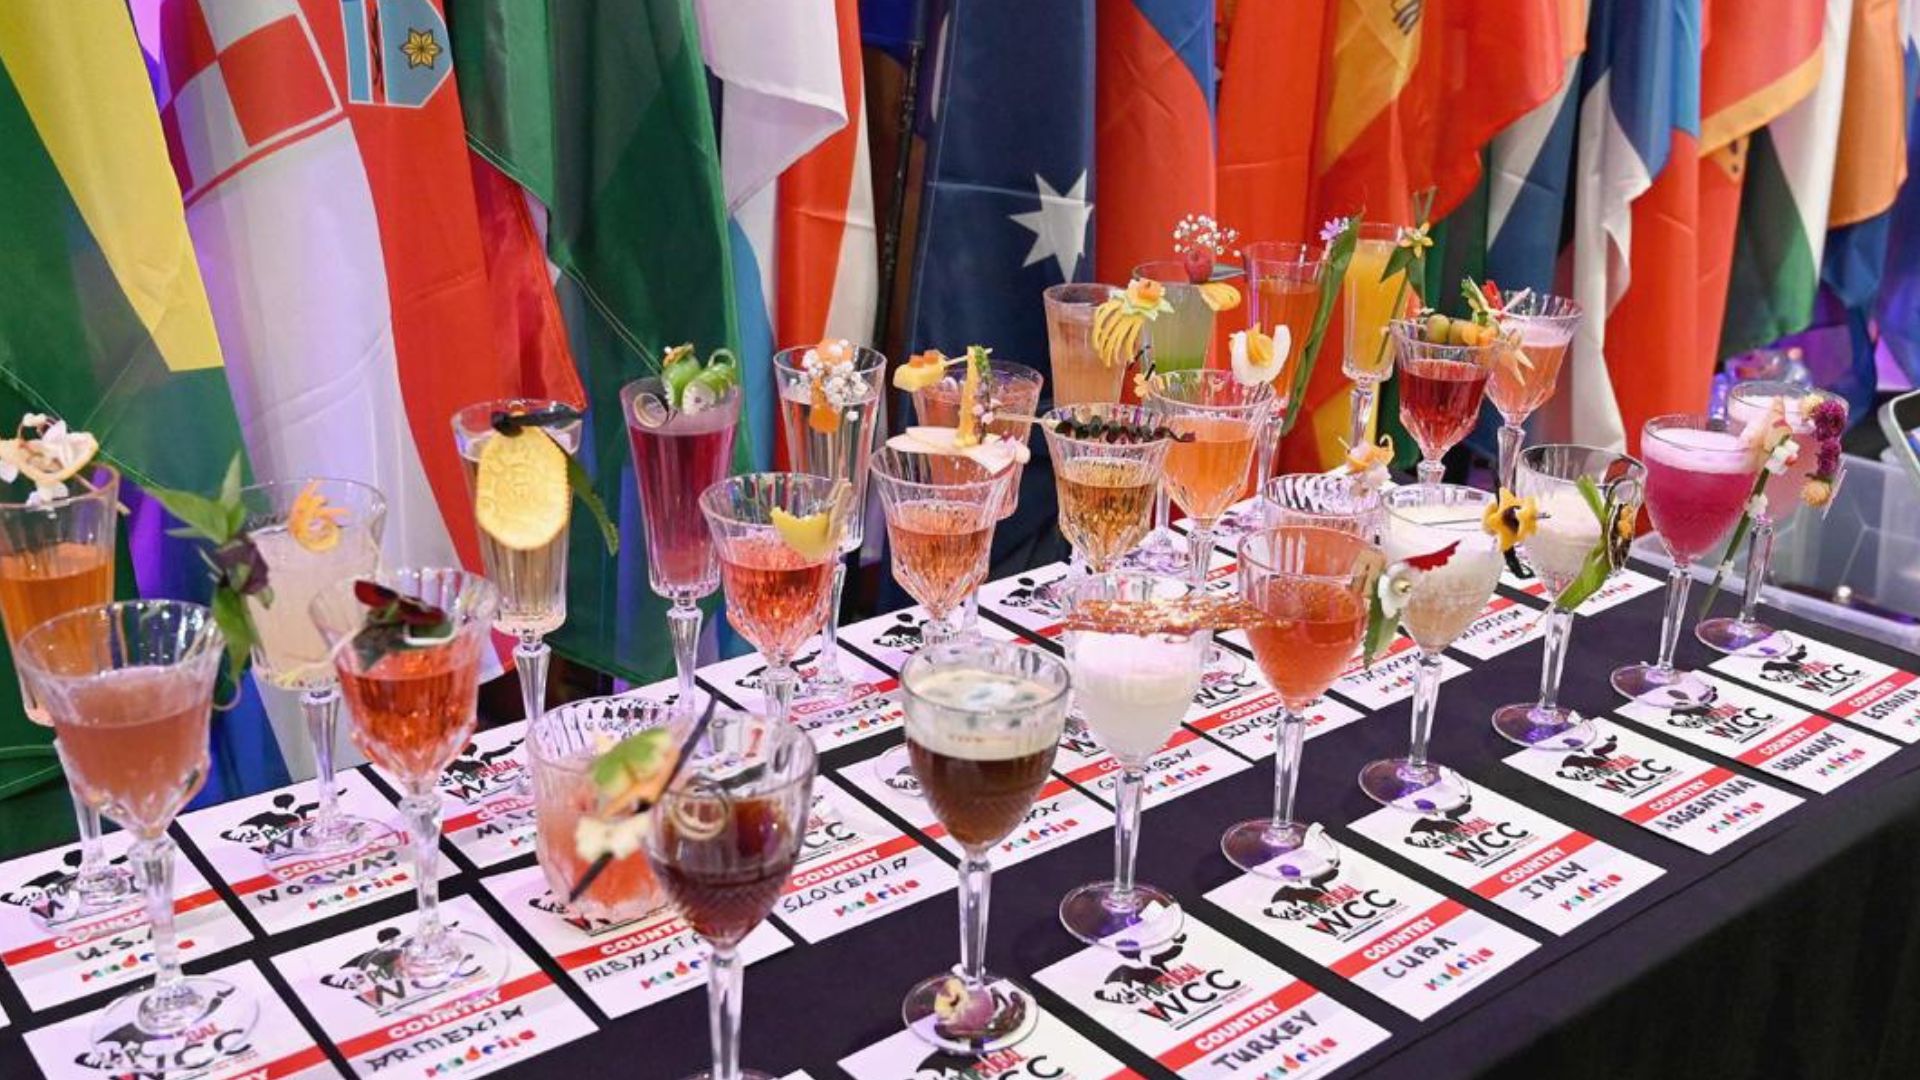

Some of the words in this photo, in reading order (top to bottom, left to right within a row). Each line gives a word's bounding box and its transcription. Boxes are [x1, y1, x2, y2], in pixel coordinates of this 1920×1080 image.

[1796, 664, 1860, 693] WCC
[1705, 707, 1773, 740] WCC
[1595, 758, 1672, 794] WCC
[1648, 779, 1708, 811] COUNTRY
[1655, 779, 1756, 831] ARGENTINA
[1445, 821, 1528, 863] WCC
[256, 850, 397, 905] NORWAY
[792, 849, 880, 887] COUNTRY
[1500, 846, 1567, 885] COUNTRY
[1520, 861, 1588, 899] ITALY
[1305, 888, 1397, 937] WCC
[1362, 917, 1437, 961] COUNTRY
[1383, 935, 1458, 979] CUBA
[387, 991, 502, 1040] COUNTRY
[1138, 969, 1241, 1022] WCC
[1195, 1000, 1280, 1051] COUNTRY
[1210, 1010, 1319, 1071] TURKEY
